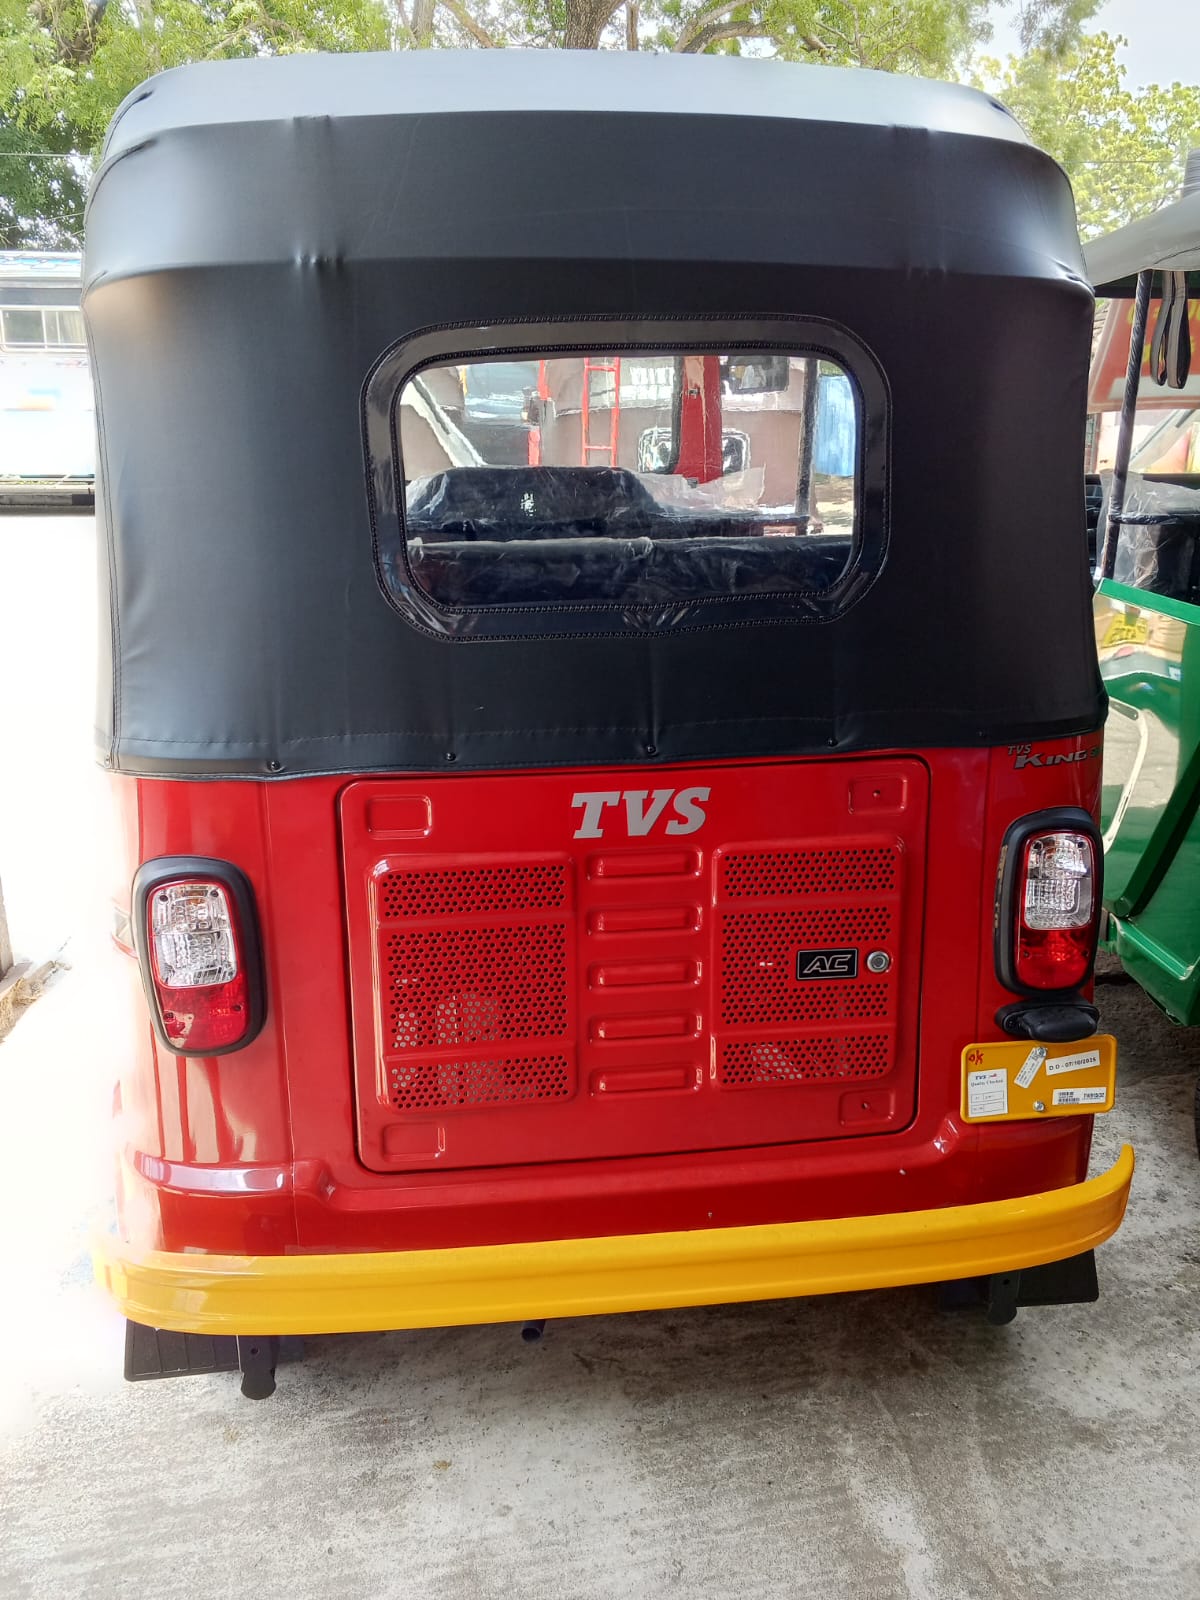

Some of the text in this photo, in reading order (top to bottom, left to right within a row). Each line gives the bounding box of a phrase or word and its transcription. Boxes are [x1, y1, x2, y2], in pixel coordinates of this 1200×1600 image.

[1008, 744, 1032, 755] TVS
[571, 787, 711, 839] TVS
[802, 954, 853, 973] AC
